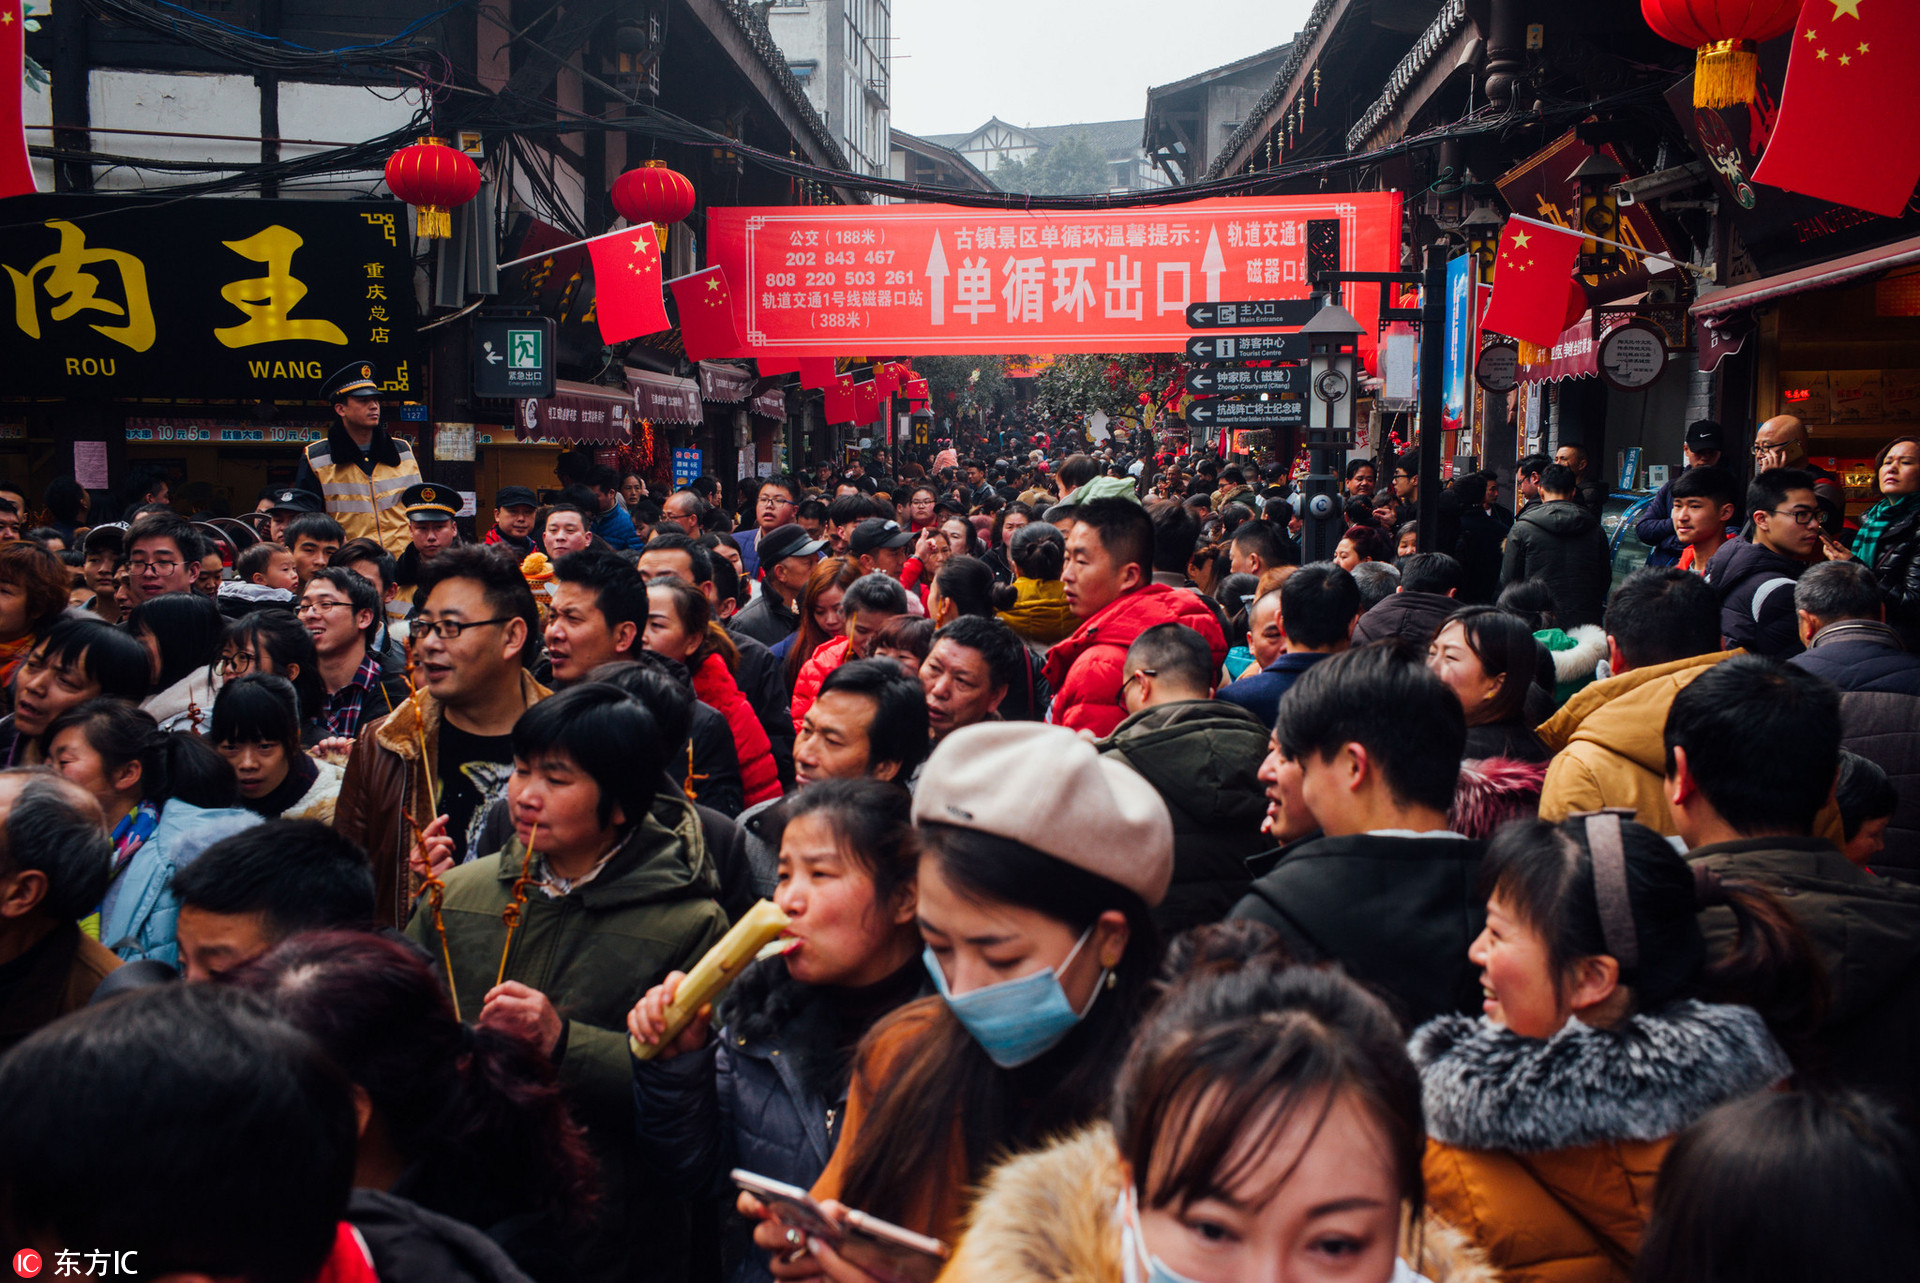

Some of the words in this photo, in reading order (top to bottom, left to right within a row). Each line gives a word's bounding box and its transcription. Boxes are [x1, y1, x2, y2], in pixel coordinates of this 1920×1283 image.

[785, 251, 817, 267] 202
[824, 250, 856, 266] 843
[864, 249, 895, 265] 467
[765, 271, 796, 288] 808
[805, 271, 836, 287] 220
[844, 270, 876, 286] 503
[885, 269, 914, 286] 261
[952, 254, 1193, 325] 单循环出口
[362, 262, 391, 344] 重庆总店
[762, 289, 924, 310] 轨道交通1号线磁器口站
[1240, 303, 1275, 316] 主入口
[1239, 337, 1285, 350] 游客中心
[65, 358, 116, 376] ROU
[248, 361, 323, 379] WANG
[508, 371, 542, 381] 紧急出口
[1240, 383, 1268, 391] Courtyard
[1268, 382, 1291, 390] (Citang)
[407, 411, 421, 420] 127
[1217, 403, 1302, 416] 抗战阵亡将士纪念碑
